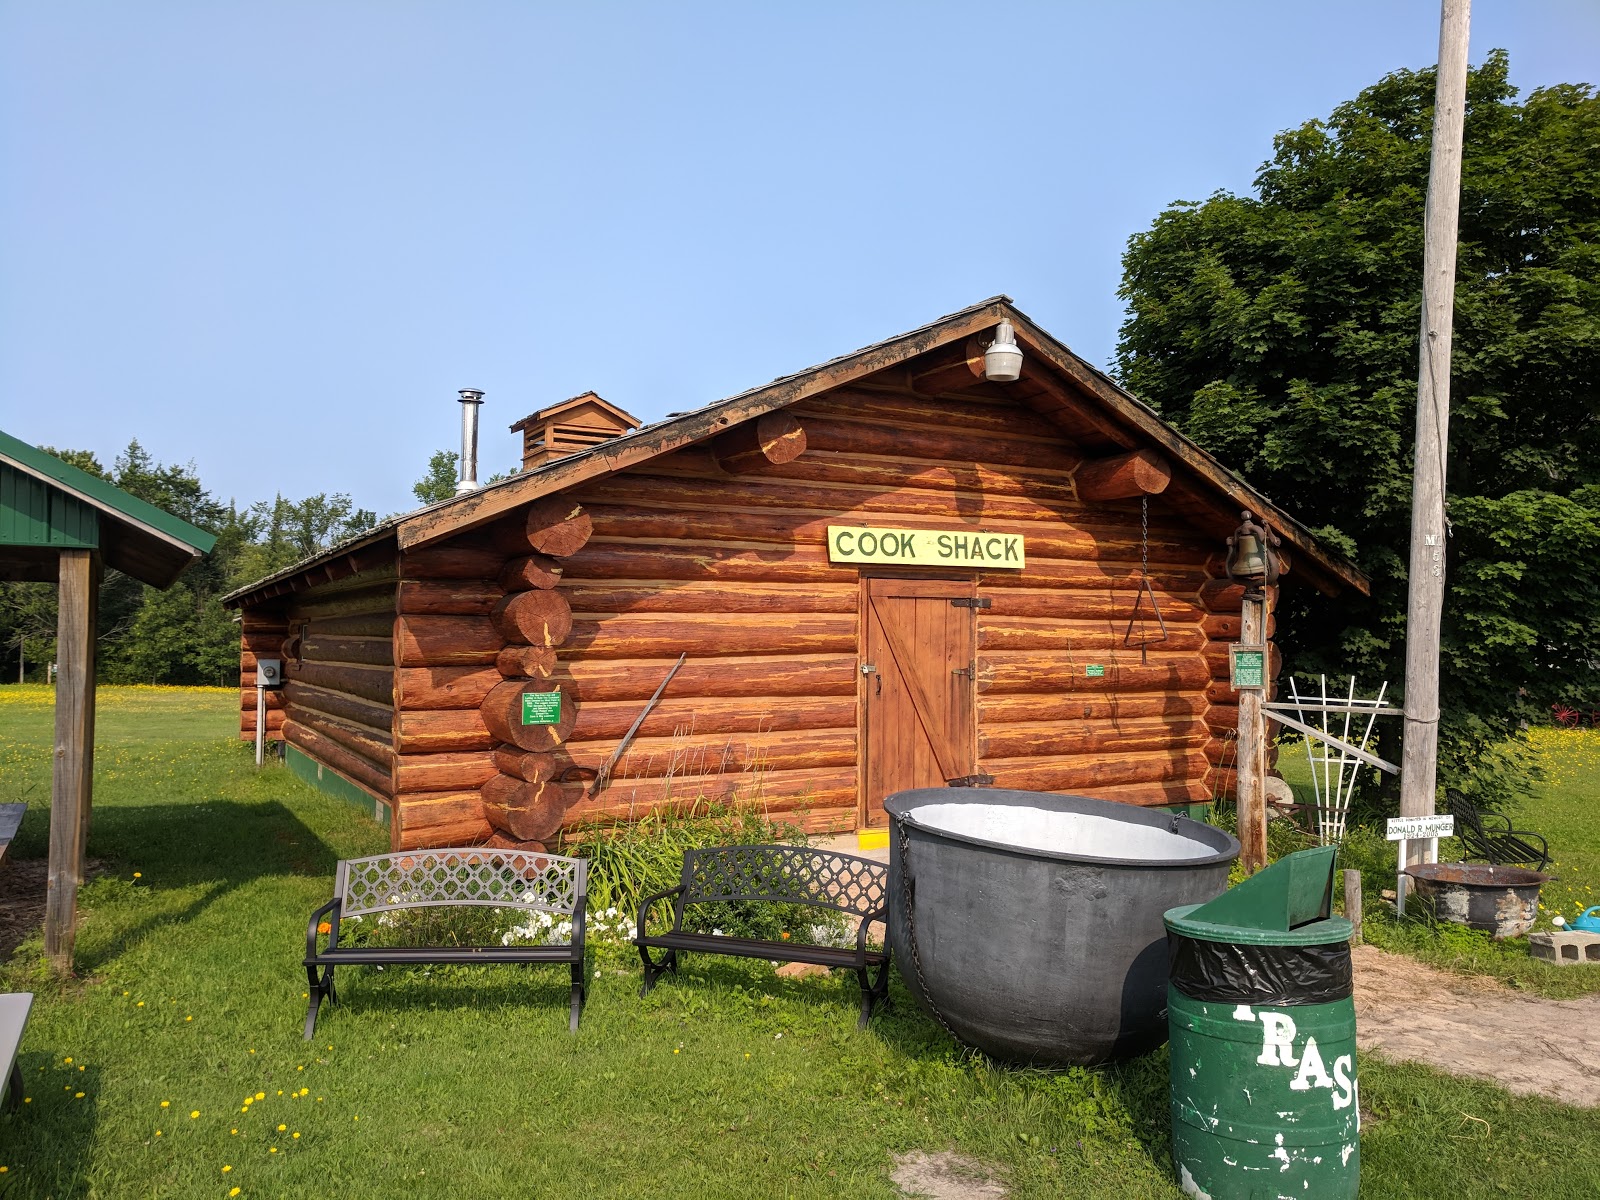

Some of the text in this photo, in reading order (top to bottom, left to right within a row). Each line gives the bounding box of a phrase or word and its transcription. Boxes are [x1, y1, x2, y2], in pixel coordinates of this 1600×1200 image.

[836, 531, 1019, 562] COOK SHACK
[1388, 825, 1416, 835] DONALD
[1425, 823, 1454, 832] MUNGER
[1232, 1004, 1361, 1133] RAS
